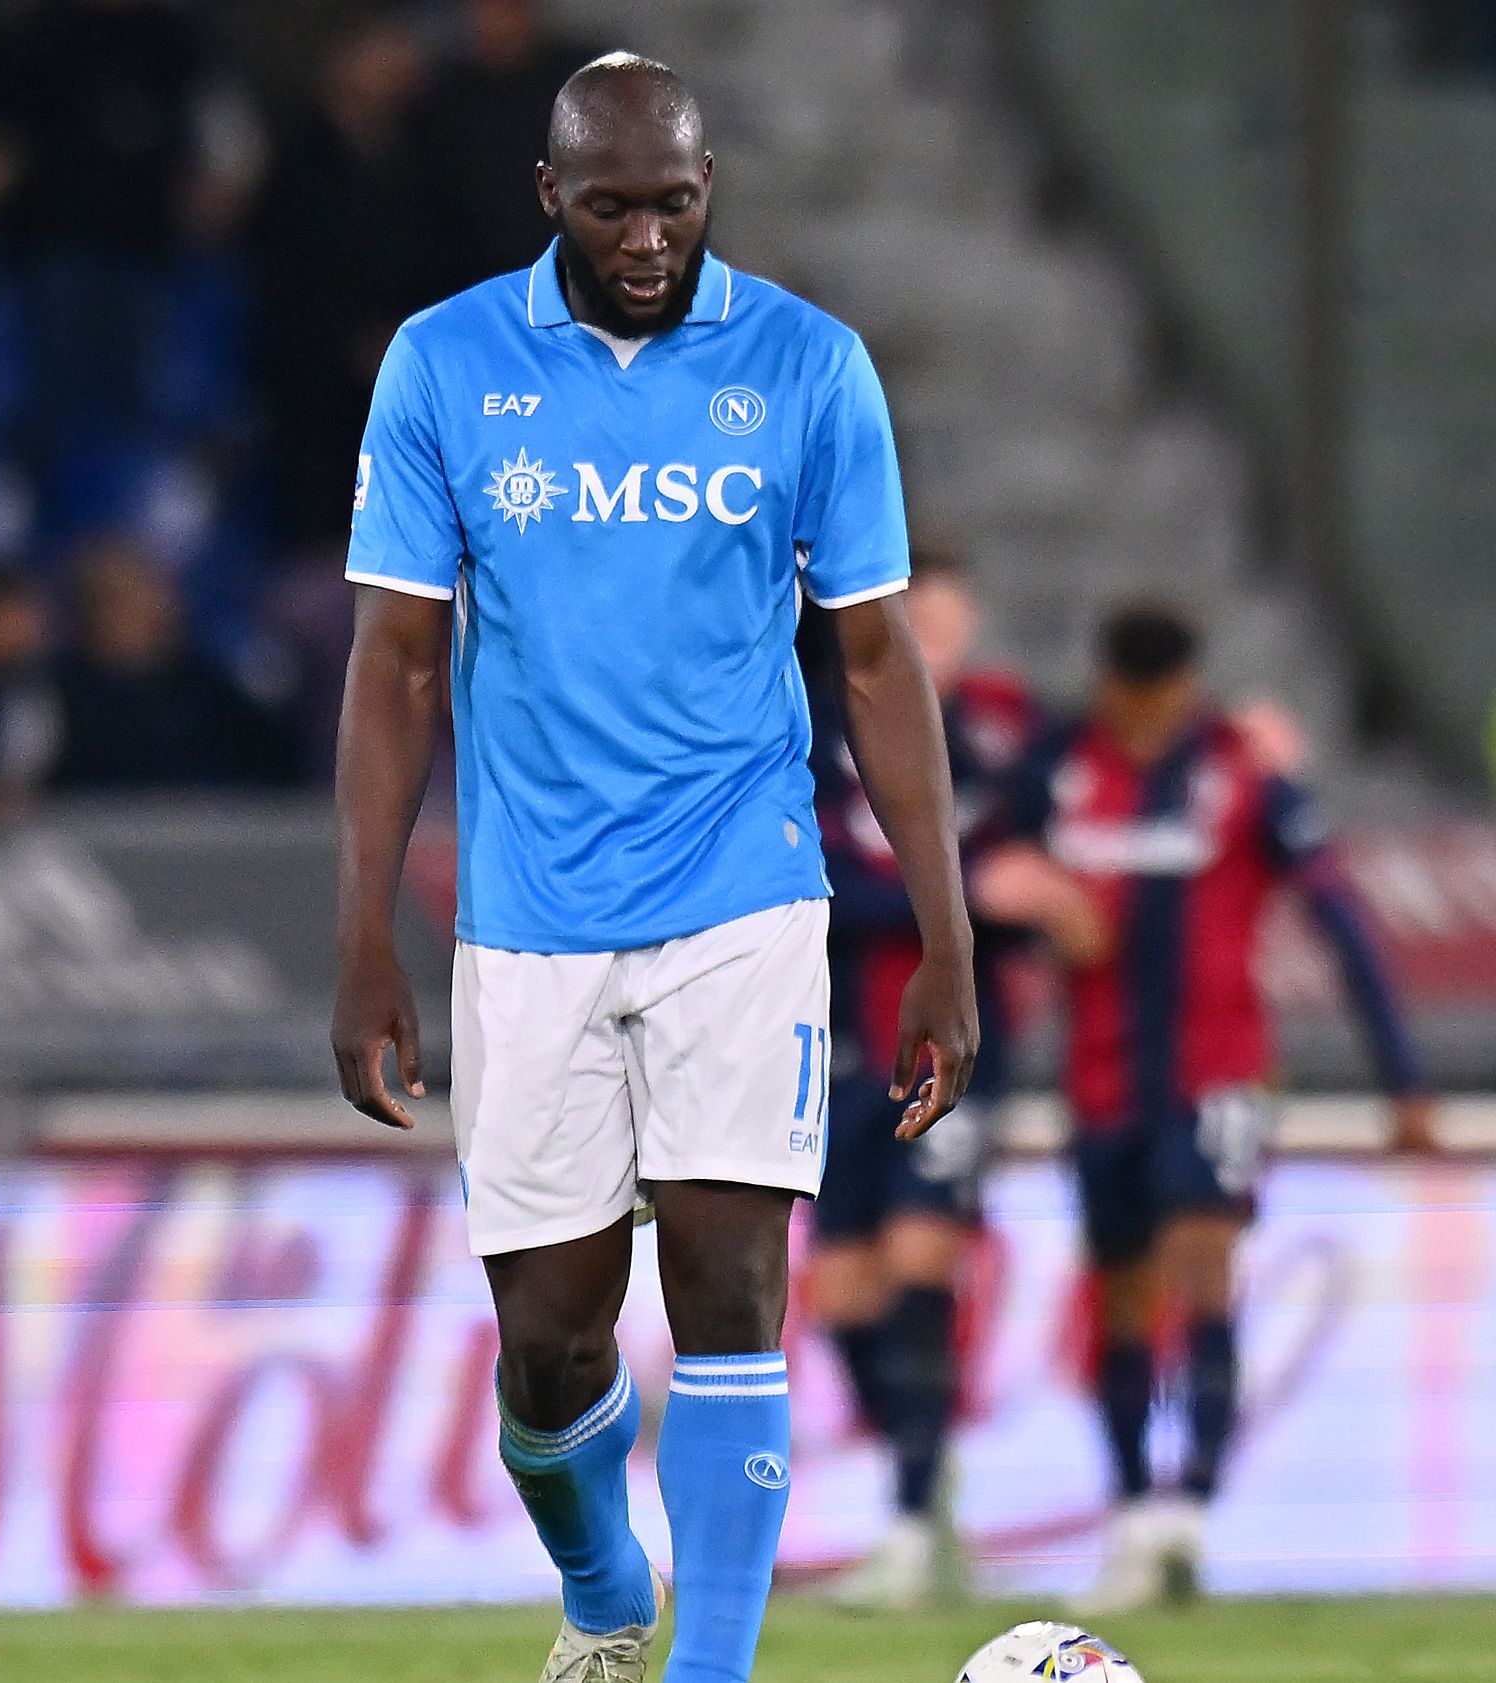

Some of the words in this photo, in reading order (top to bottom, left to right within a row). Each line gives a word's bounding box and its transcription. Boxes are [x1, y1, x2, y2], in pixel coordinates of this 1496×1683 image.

[483, 393, 542, 417] EA7
[727, 399, 749, 423] N
[571, 462, 762, 526] MSC
[793, 1022, 825, 1125] 11
